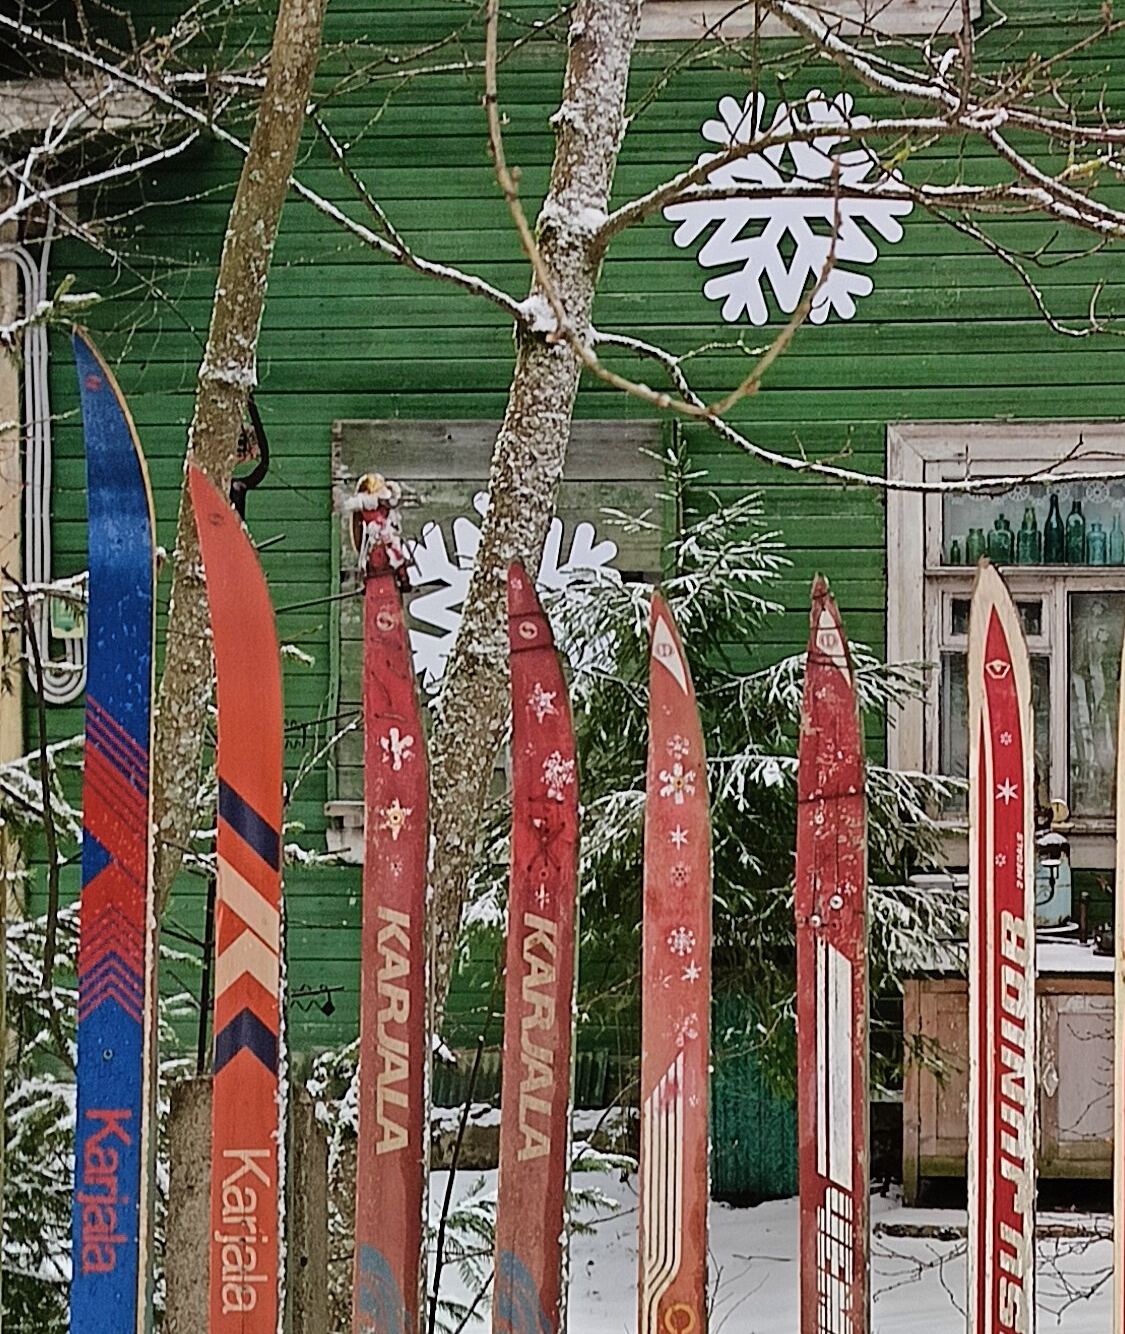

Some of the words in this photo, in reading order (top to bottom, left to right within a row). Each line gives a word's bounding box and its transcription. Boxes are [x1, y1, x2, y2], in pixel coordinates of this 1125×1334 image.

[375, 908, 411, 1155] KARJALA
[517, 911, 557, 1161] KARJALA
[1000, 910, 1028, 1215] JUNIOR
[80, 1108, 133, 1276] Karjala
[213, 1148, 271, 1315] Karjala
